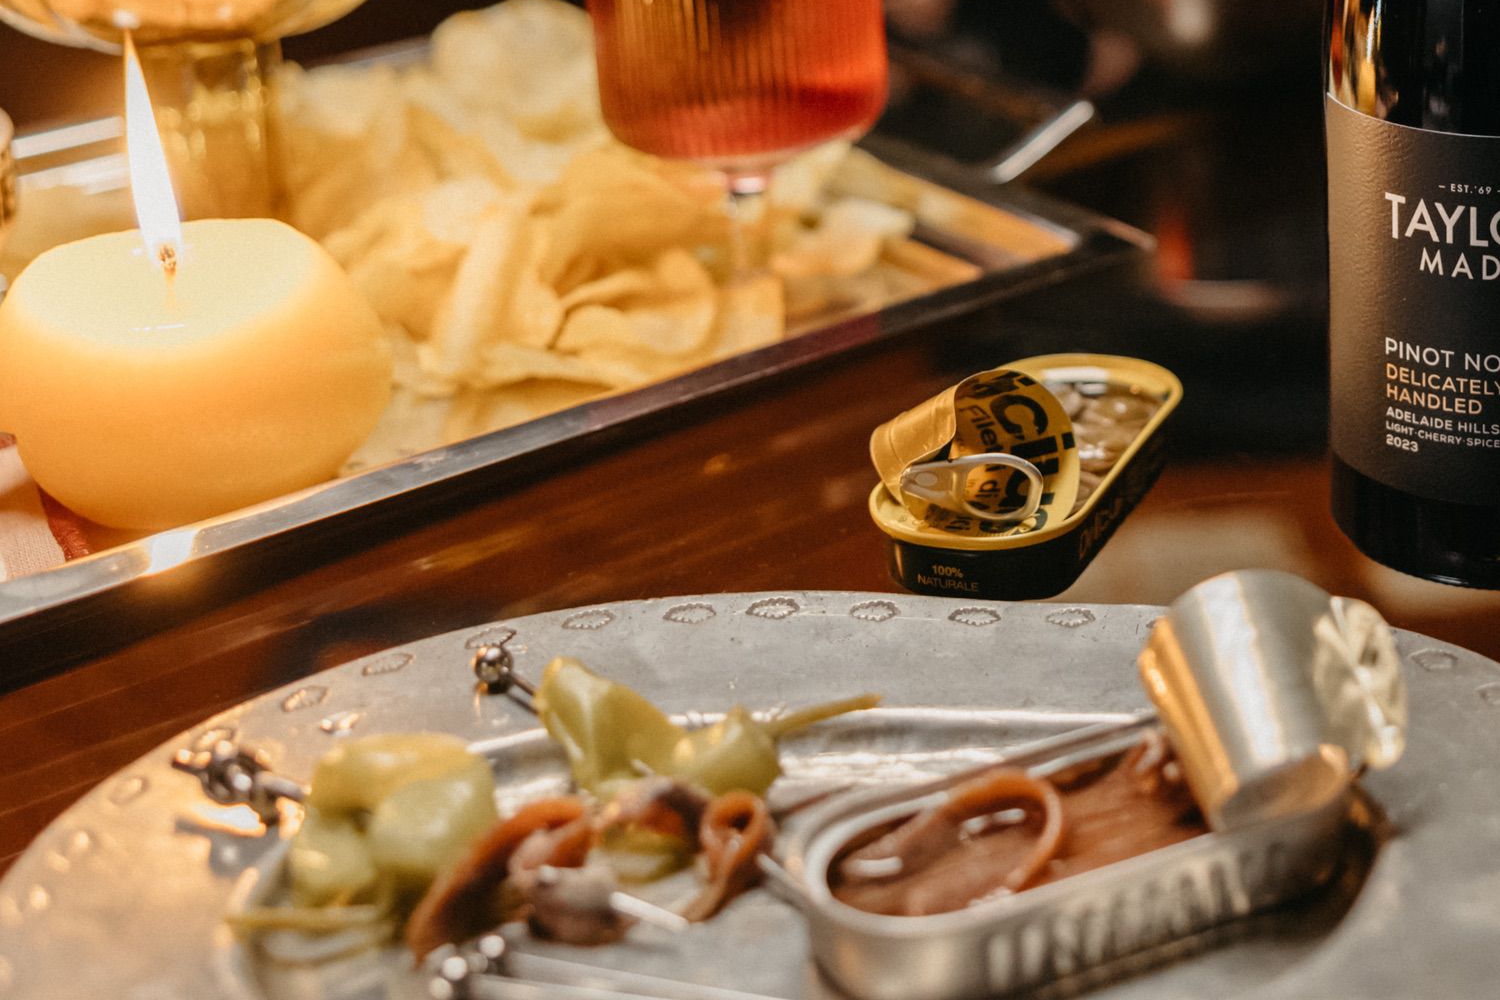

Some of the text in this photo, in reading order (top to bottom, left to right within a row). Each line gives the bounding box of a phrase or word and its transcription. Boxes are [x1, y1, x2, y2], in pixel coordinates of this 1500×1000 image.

[1385, 336, 1455, 368] PINOT
[1386, 383, 1483, 415] HANDLED
[1386, 406, 1500, 435] ADELAIDE HILLS
[1386, 434, 1419, 452] 2023
[917, 573, 979, 592] NATURALE
[932, 564, 964, 578] 100%
